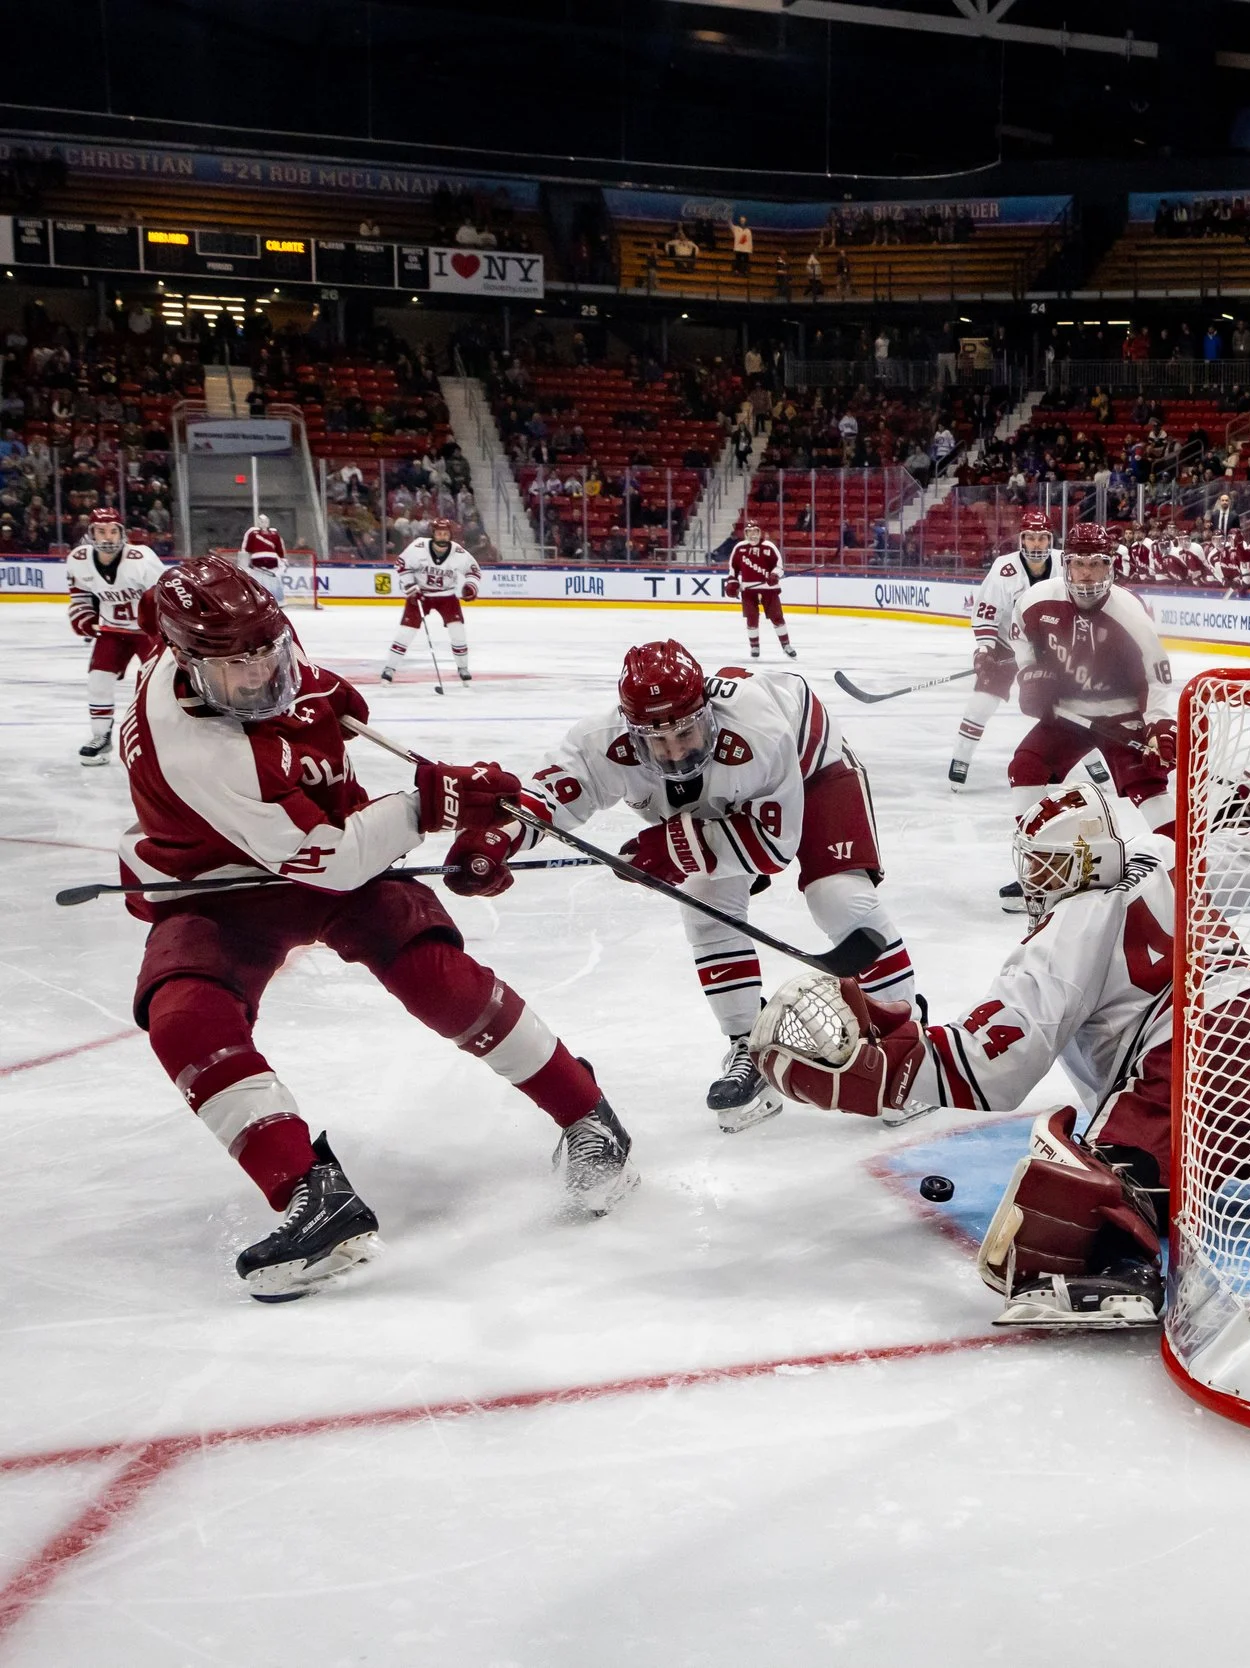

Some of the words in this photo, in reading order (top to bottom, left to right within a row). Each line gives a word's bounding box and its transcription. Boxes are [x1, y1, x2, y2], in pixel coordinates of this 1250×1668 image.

[64, 147, 194, 175] CHRISTIAN
[268, 164, 312, 185] ROB
[265, 238, 306, 254] COLGATE
[433, 252, 448, 276] I
[483, 254, 541, 283] NY
[580, 305, 598, 316] 25
[1030, 303, 1046, 314] 24
[0, 562, 44, 589] POLAR
[492, 574, 528, 582] ATHLETIC
[564, 575, 606, 597] POLAR
[164, 577, 193, 609] gate
[874, 583, 931, 608] QUINNIPIAC
[976, 601, 997, 621] 22
[1161, 609, 1178, 626] 2023
[1179, 612, 1202, 627] ECAC
[1203, 613, 1239, 630] HOCKEY
[1153, 660, 1172, 685] 18
[649, 684, 662, 696] 19
[532, 763, 583, 804] 19
[673, 783, 685, 795] H
[279, 845, 336, 875] 14
[546, 857, 593, 869] CCM
[963, 999, 1026, 1061] 44
[893, 1057, 913, 1107] TRUE
